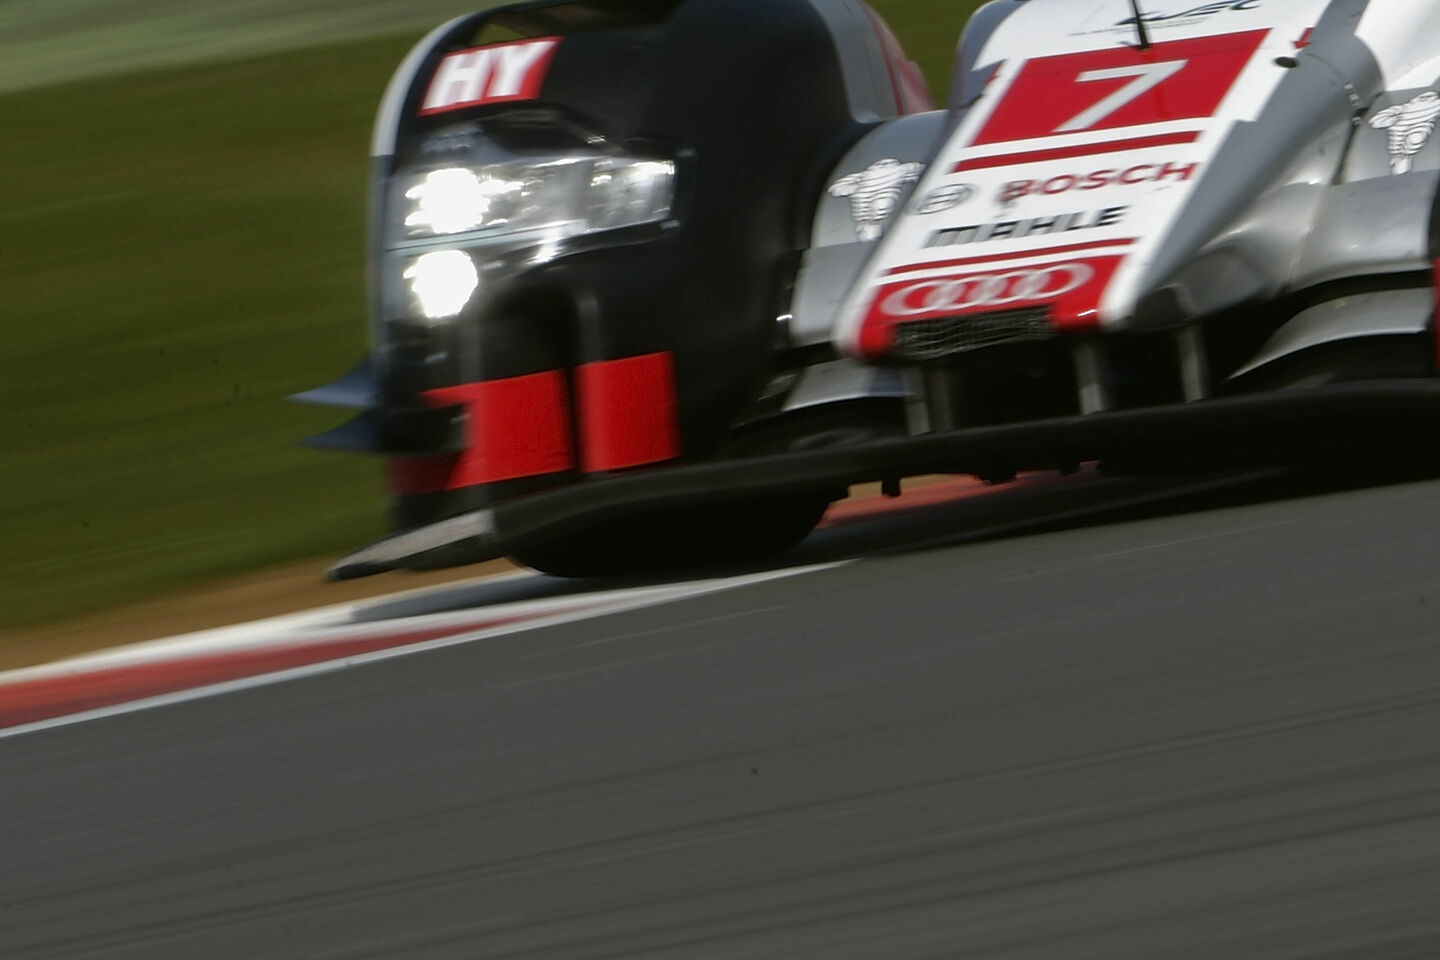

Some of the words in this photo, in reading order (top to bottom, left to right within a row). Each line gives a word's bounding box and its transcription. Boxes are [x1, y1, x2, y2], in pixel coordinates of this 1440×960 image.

[421, 40, 558, 111] HY
[1050, 59, 1190, 133] 7
[996, 161, 1204, 203] BOSCH
